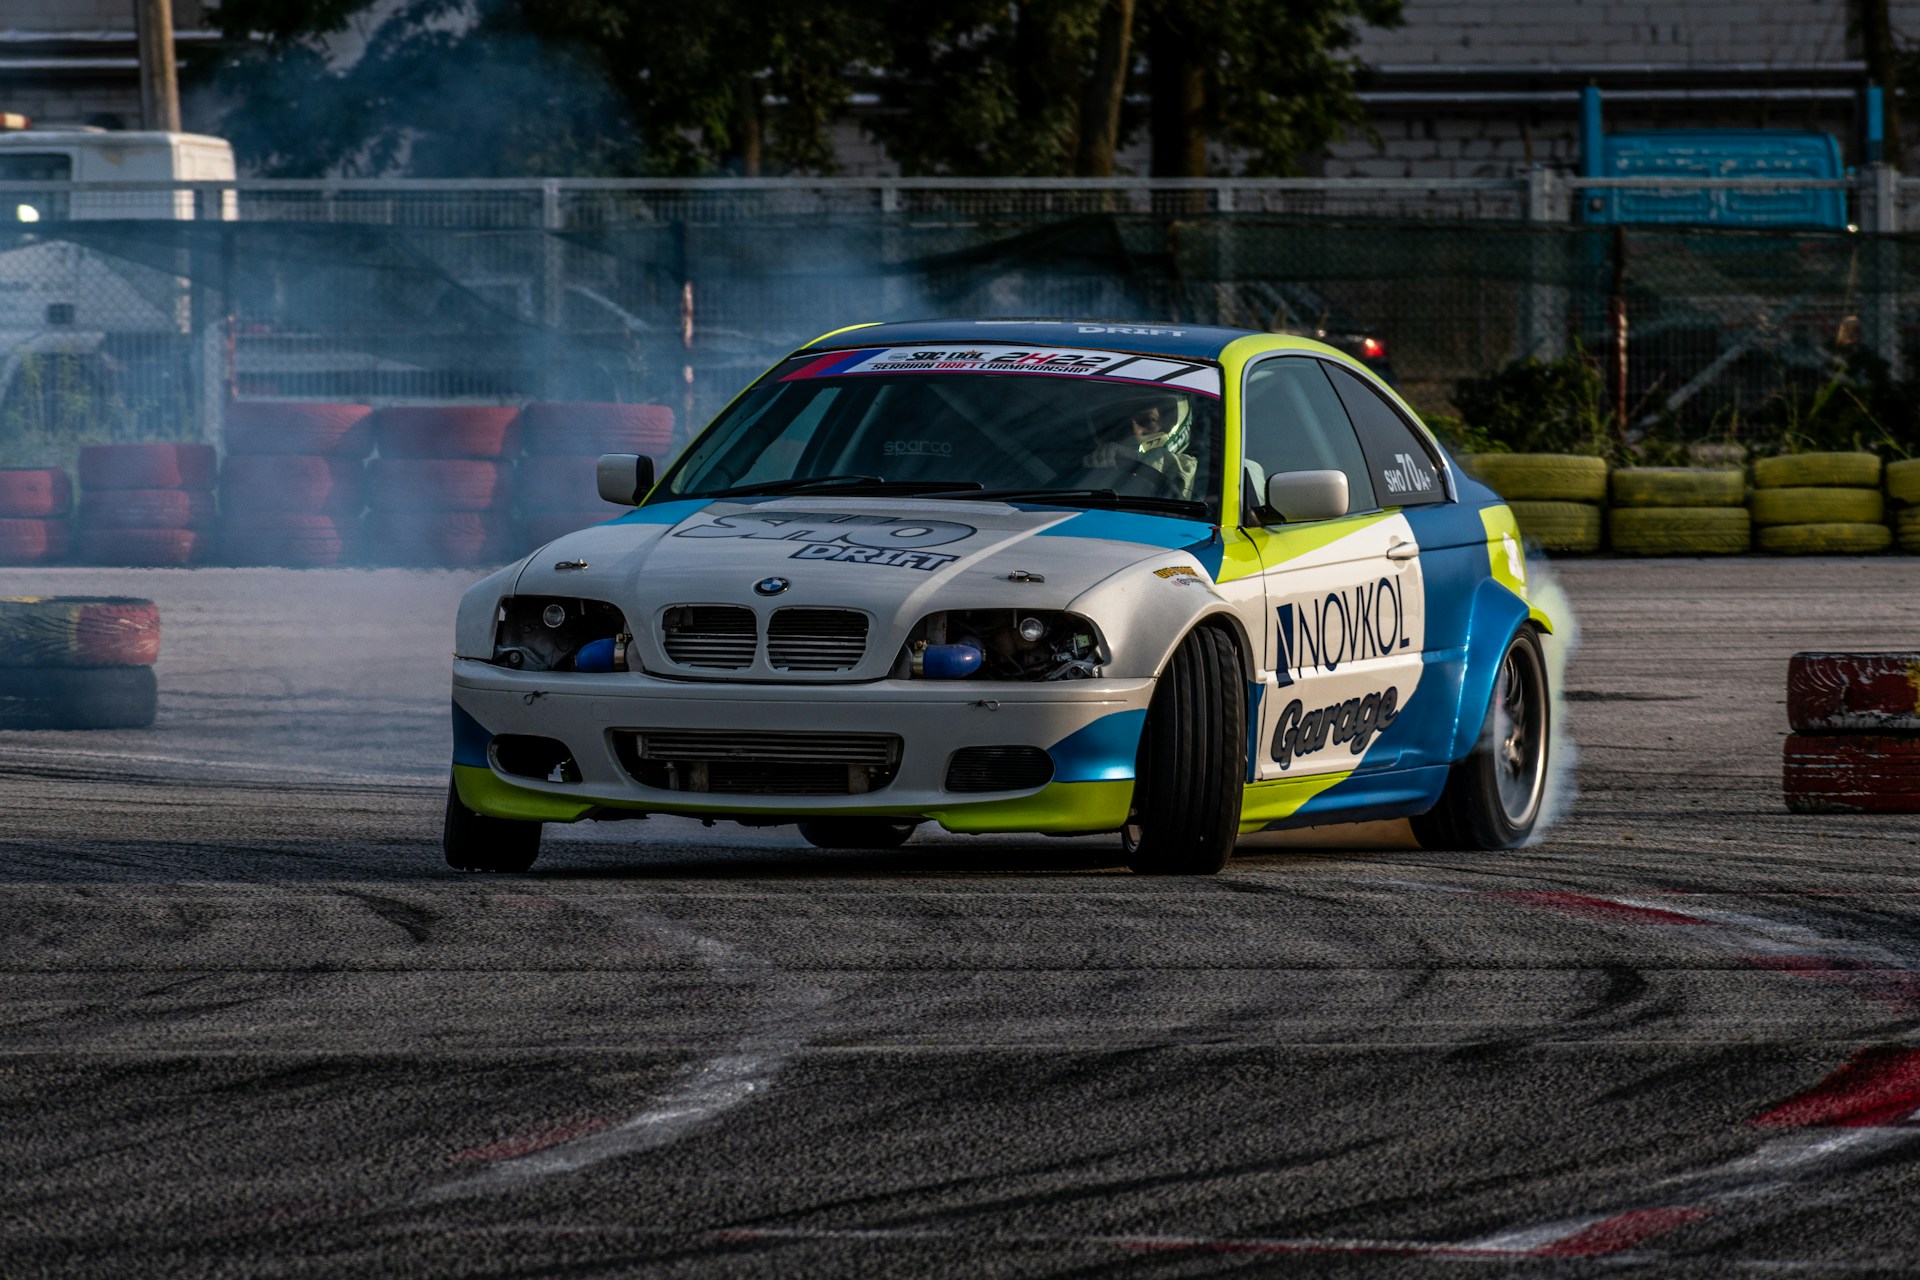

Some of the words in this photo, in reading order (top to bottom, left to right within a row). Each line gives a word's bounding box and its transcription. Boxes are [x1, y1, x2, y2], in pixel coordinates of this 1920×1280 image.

[1078, 326, 1187, 337] DRIFT
[871, 362, 936, 371] SERBIAN
[934, 361, 976, 369] DRIFT
[978, 362, 1090, 374] CHAMPIONSHIP
[883, 440, 952, 456] sparco
[672, 511, 978, 549] SHO
[787, 543, 962, 571] DRIFT
[1298, 574, 1410, 679] NOVKOL
[1270, 686, 1399, 771] Garage
